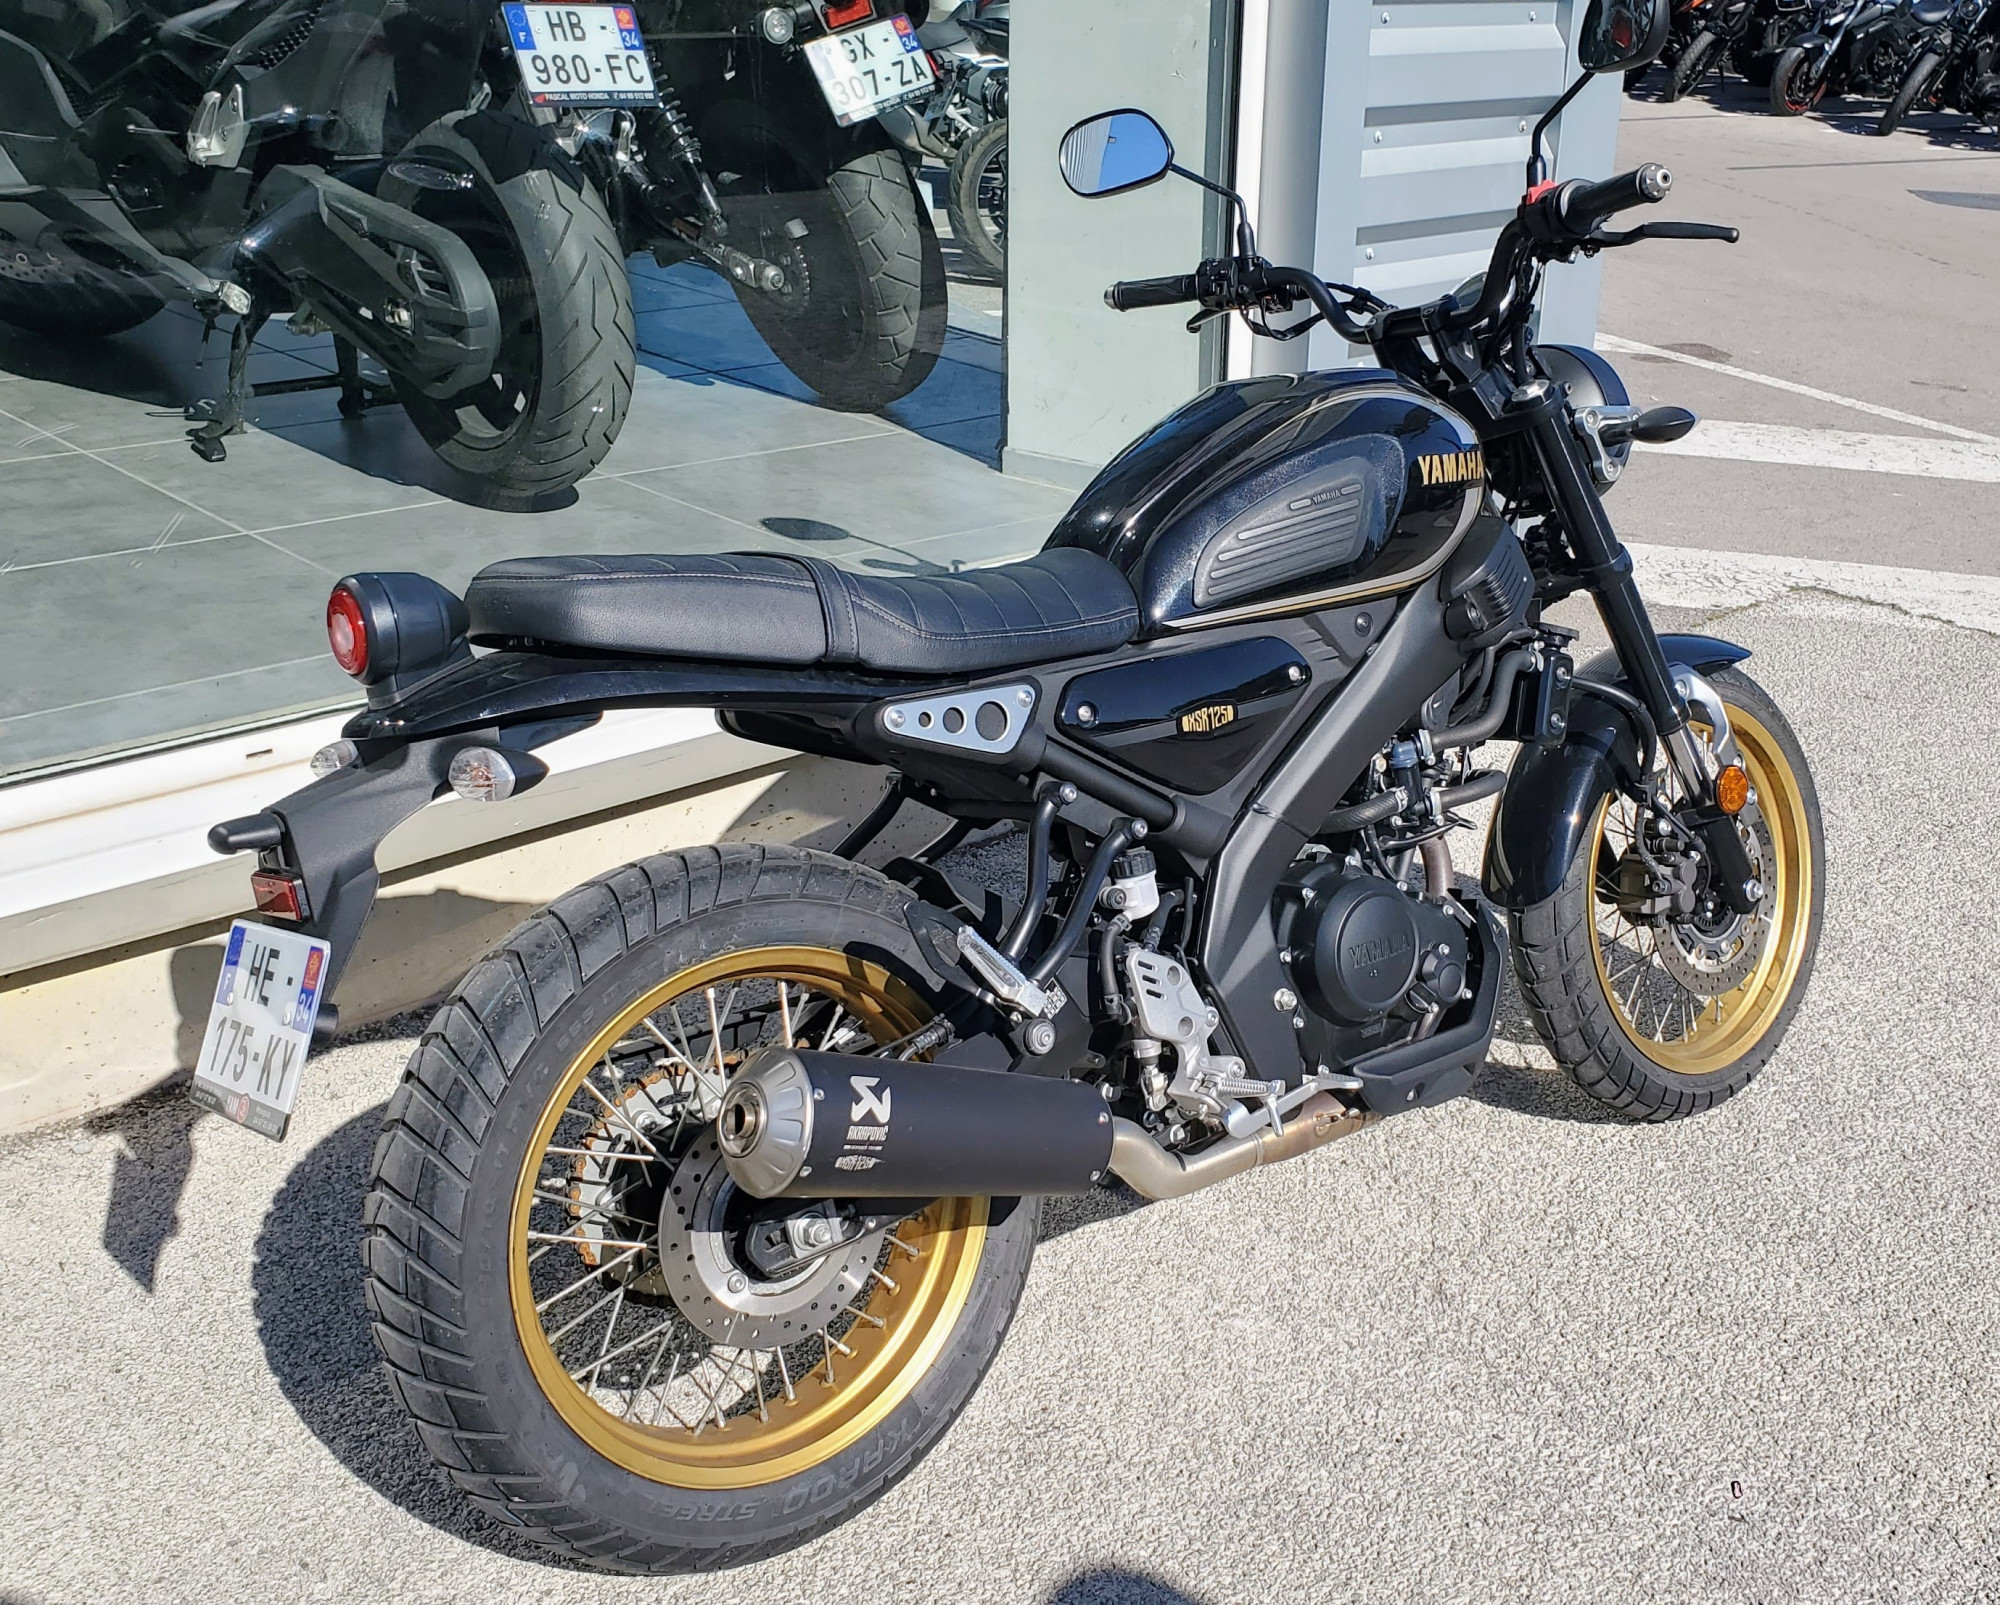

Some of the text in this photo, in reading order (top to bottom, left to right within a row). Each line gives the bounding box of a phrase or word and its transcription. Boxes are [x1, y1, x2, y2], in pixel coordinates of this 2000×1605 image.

[518, 31, 526, 43] F
[545, 11, 587, 42] HB
[621, 31, 640, 48] 34
[901, 34, 918, 51] 34
[531, 54, 644, 85] 980-FC
[832, 56, 928, 106] 307-ZA
[545, 92, 570, 101] PASCAL
[569, 92, 588, 101] MOTO
[588, 92, 610, 101] HONDA
[1417, 450, 1484, 486] YAMAHA
[1312, 490, 1341, 505] YAMAHA
[1188, 705, 1228, 732] XSR125
[1348, 932, 1411, 969] YAMAHA
[244, 943, 280, 1007] HE
[295, 993, 313, 1025] 34
[210, 1016, 297, 1100] 175-KY
